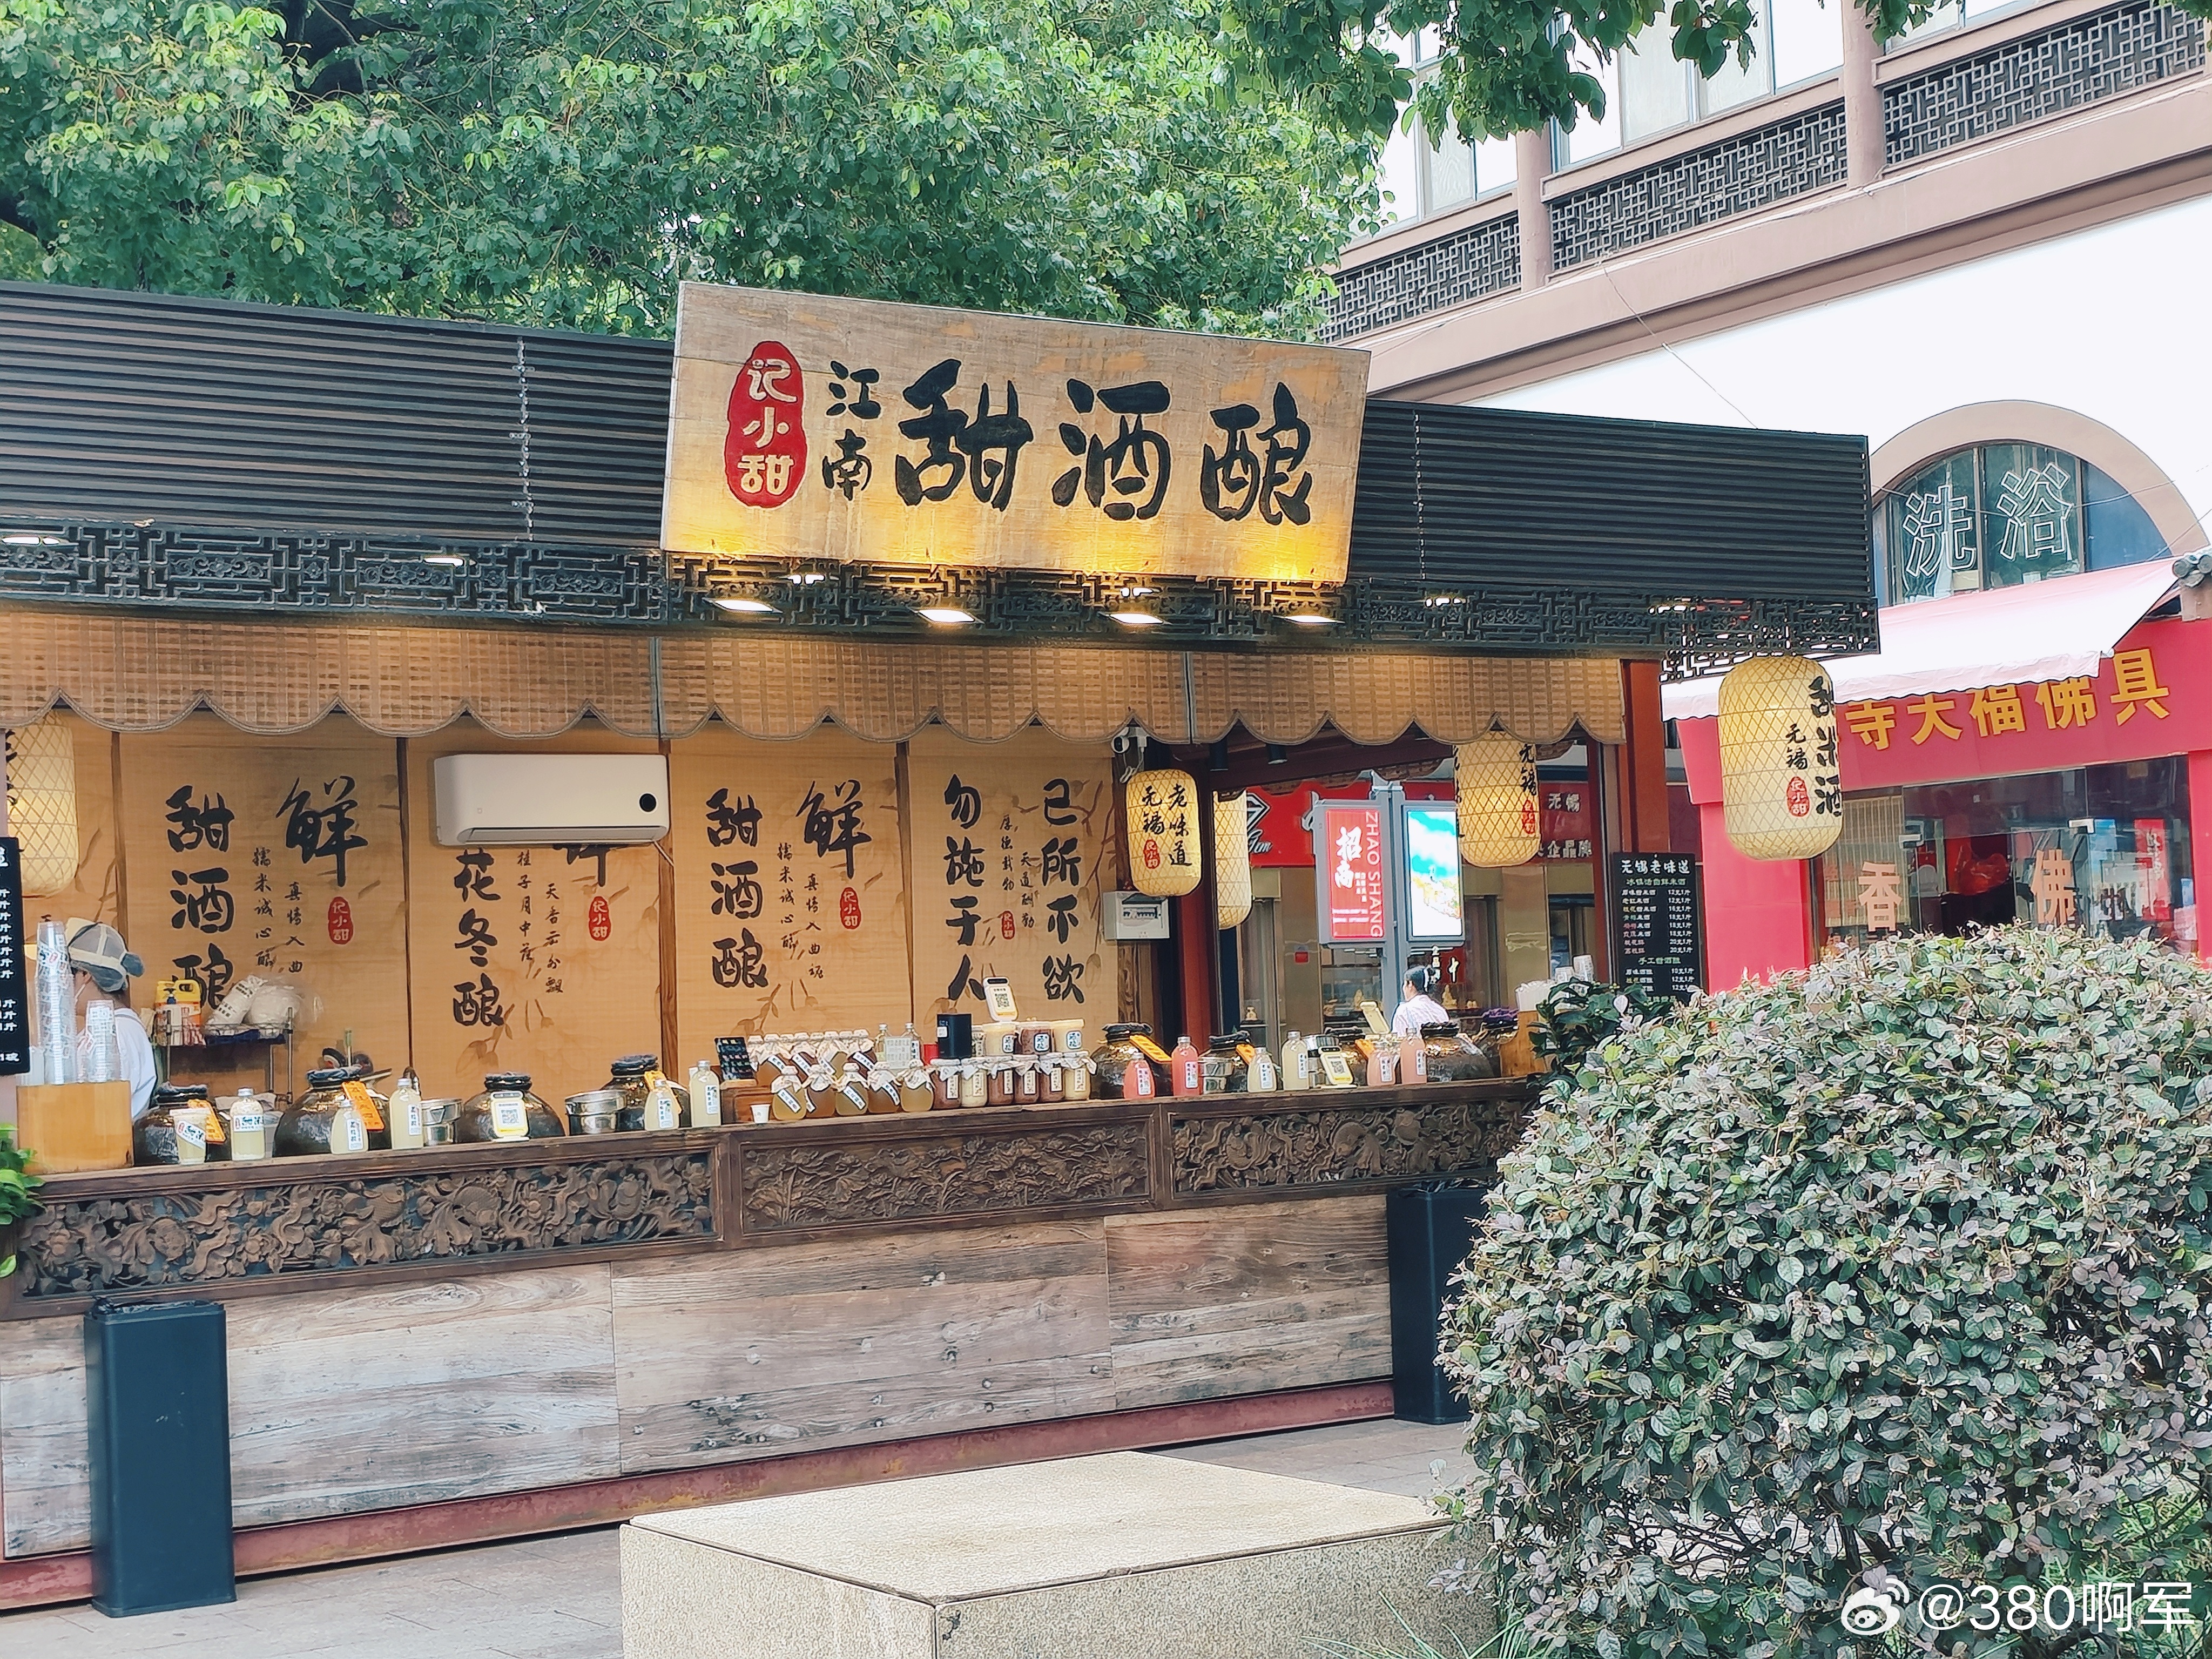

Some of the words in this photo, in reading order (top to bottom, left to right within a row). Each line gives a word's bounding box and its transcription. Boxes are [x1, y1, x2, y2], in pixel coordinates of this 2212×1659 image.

[739, 358, 798, 496] 记小甜
[820, 359, 881, 501] 江南
[894, 357, 1312, 525] 甜酒酿
[1901, 462, 2073, 577] 洗浴
[1844, 648, 2171, 751] 寺大福佛具
[1785, 723, 1809, 770] 无锡
[275, 775, 368, 888] 鲜
[795, 779, 873, 879] 鲜
[1142, 785, 1165, 835] 无锡
[1168, 783, 1193, 867] 老味道
[1365, 812, 1381, 866] ZHAO
[1548, 792, 1581, 812] 无锡
[705, 787, 769, 990] 甜酒酿
[943, 773, 986, 1001] 勿施于人
[999, 814, 1015, 891] 厚德载物
[1041, 777, 1085, 1004] 己所不欲
[1334, 826, 1363, 889] 招商
[1621, 859, 1690, 874] 无锡老味道
[2030, 848, 2075, 924] 佛
[165, 785, 235, 1010] 甜酒酿
[332, 901, 350, 941] 记小甜
[592, 900, 609, 939] 记小甜
[842, 890, 859, 927] 记小甜
[1367, 872, 1383, 938] SHANG
[1858, 861, 1903, 932] 香
[452, 847, 505, 1027] 花冬酿
